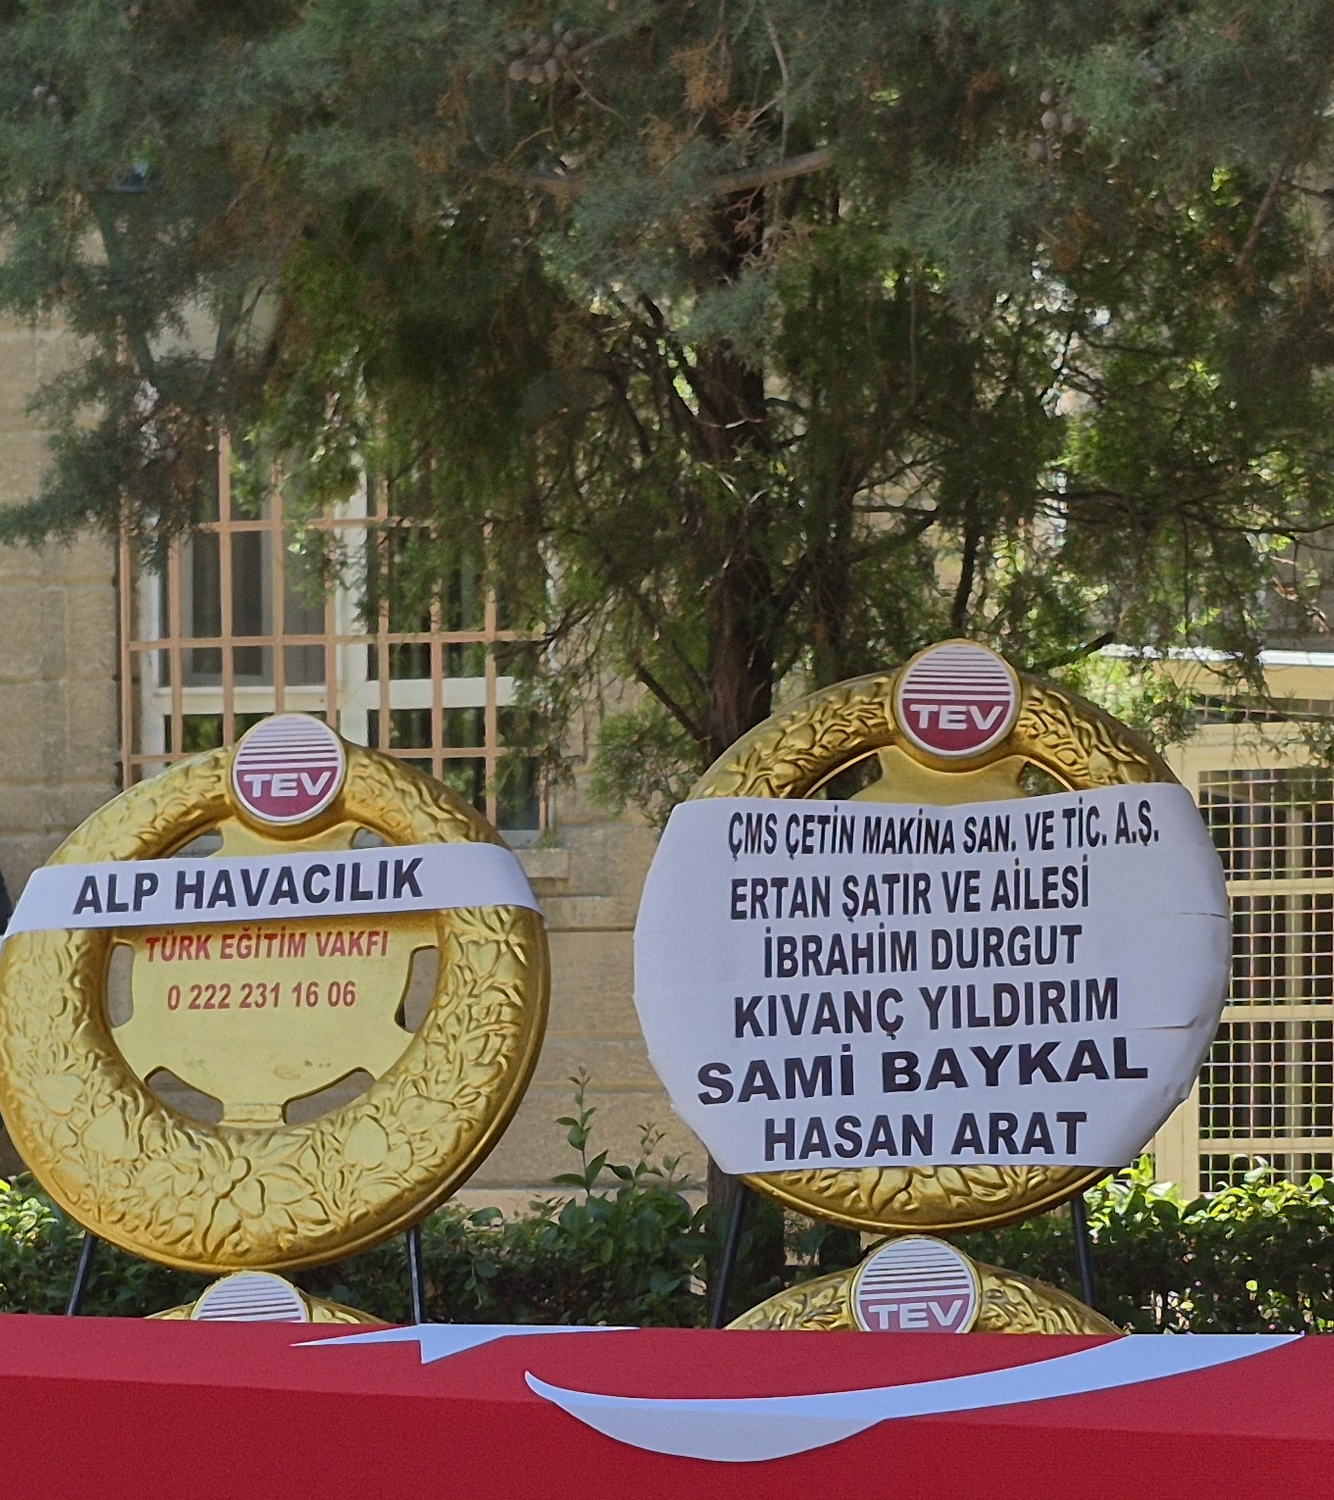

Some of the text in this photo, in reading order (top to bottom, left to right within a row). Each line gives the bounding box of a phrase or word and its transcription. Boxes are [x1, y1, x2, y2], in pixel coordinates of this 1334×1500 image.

[910, 704, 1003, 730] TEV
[244, 771, 332, 797] TEV
[728, 796, 1160, 861] ÇMS ÇETİN MAKİNA SAN. VE TİC. A.Ş.
[72, 857, 423, 915] ALP HAVACILIK
[730, 853, 1090, 922] ERTAN ŞATIR VE AİLESİ
[145, 926, 389, 962] TÜRK EĞİTİM VAKFI
[763, 922, 1083, 979] İBRAHİM DURGUT
[167, 980, 357, 1010] 0 222 231 16 06
[734, 976, 1118, 1041] KIVANÇ YILDIRIM
[697, 1037, 1149, 1106] SAMİ BAYKAL
[764, 1112, 1087, 1162] HASAN ARAT
[868, 1300, 963, 1329] TEV
